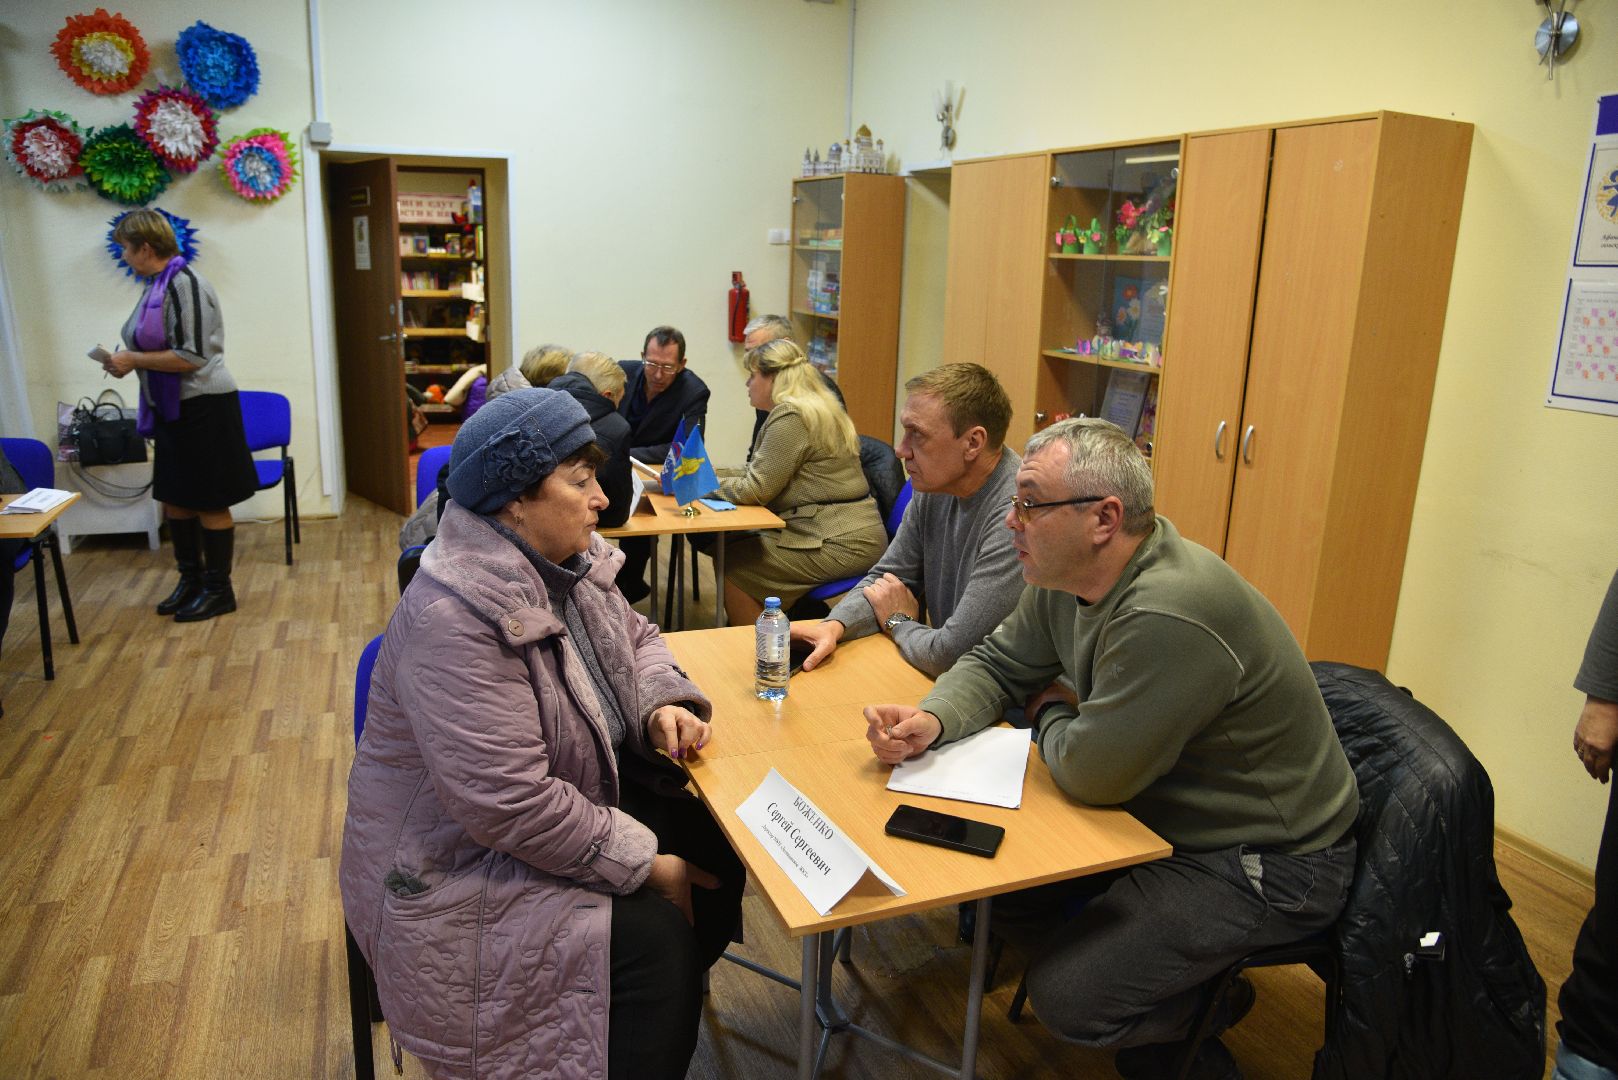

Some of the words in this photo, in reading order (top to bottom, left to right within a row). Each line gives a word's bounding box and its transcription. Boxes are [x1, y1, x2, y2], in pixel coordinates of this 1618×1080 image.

[767, 802, 794, 833] Сергей
[790, 828, 832, 876] Сергеевич
[793, 796, 834, 840] БОЖЕНКО
